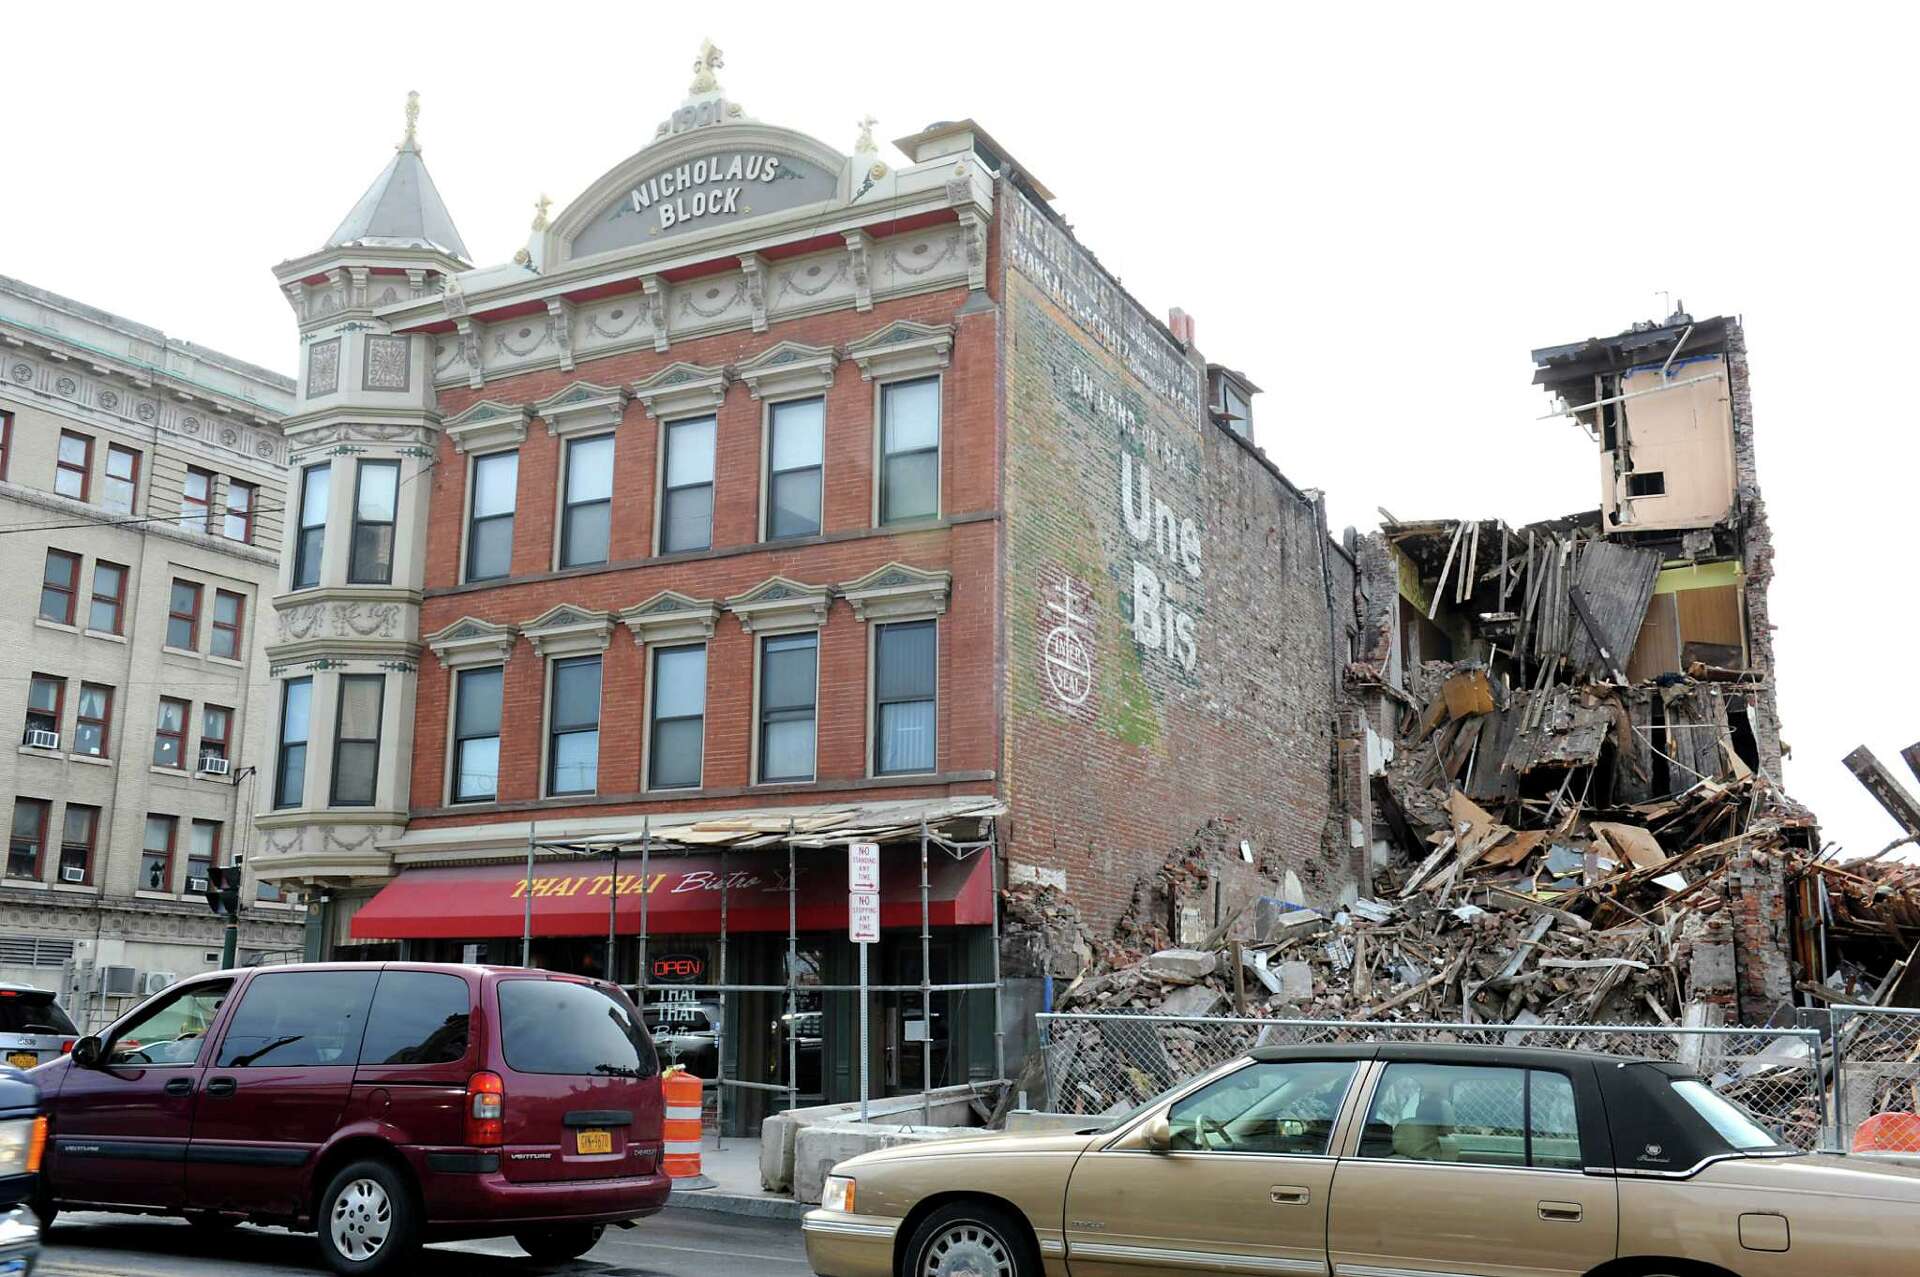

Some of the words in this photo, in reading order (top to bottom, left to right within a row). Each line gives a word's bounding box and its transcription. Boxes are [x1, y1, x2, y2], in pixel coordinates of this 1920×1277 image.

[671, 98, 723, 134] 1901
[631, 154, 779, 213] NICHOLAUS
[658, 186, 742, 230] BLOCK
[1071, 365, 1094, 402] ON
[1099, 384, 1137, 436] LAND
[1165, 439, 1187, 474] SEA
[858, 846, 870, 856] NO
[509, 876, 589, 899] THAI
[586, 873, 668, 896] THAI
[670, 869, 762, 893] Bistro
[858, 895, 870, 906] NO
[858, 914, 870, 922] ANY
[653, 959, 702, 977] OPEN
[659, 988, 697, 1002] THAI
[658, 1004, 696, 1021] THAI
[510, 1152, 552, 1160] VENTURE
